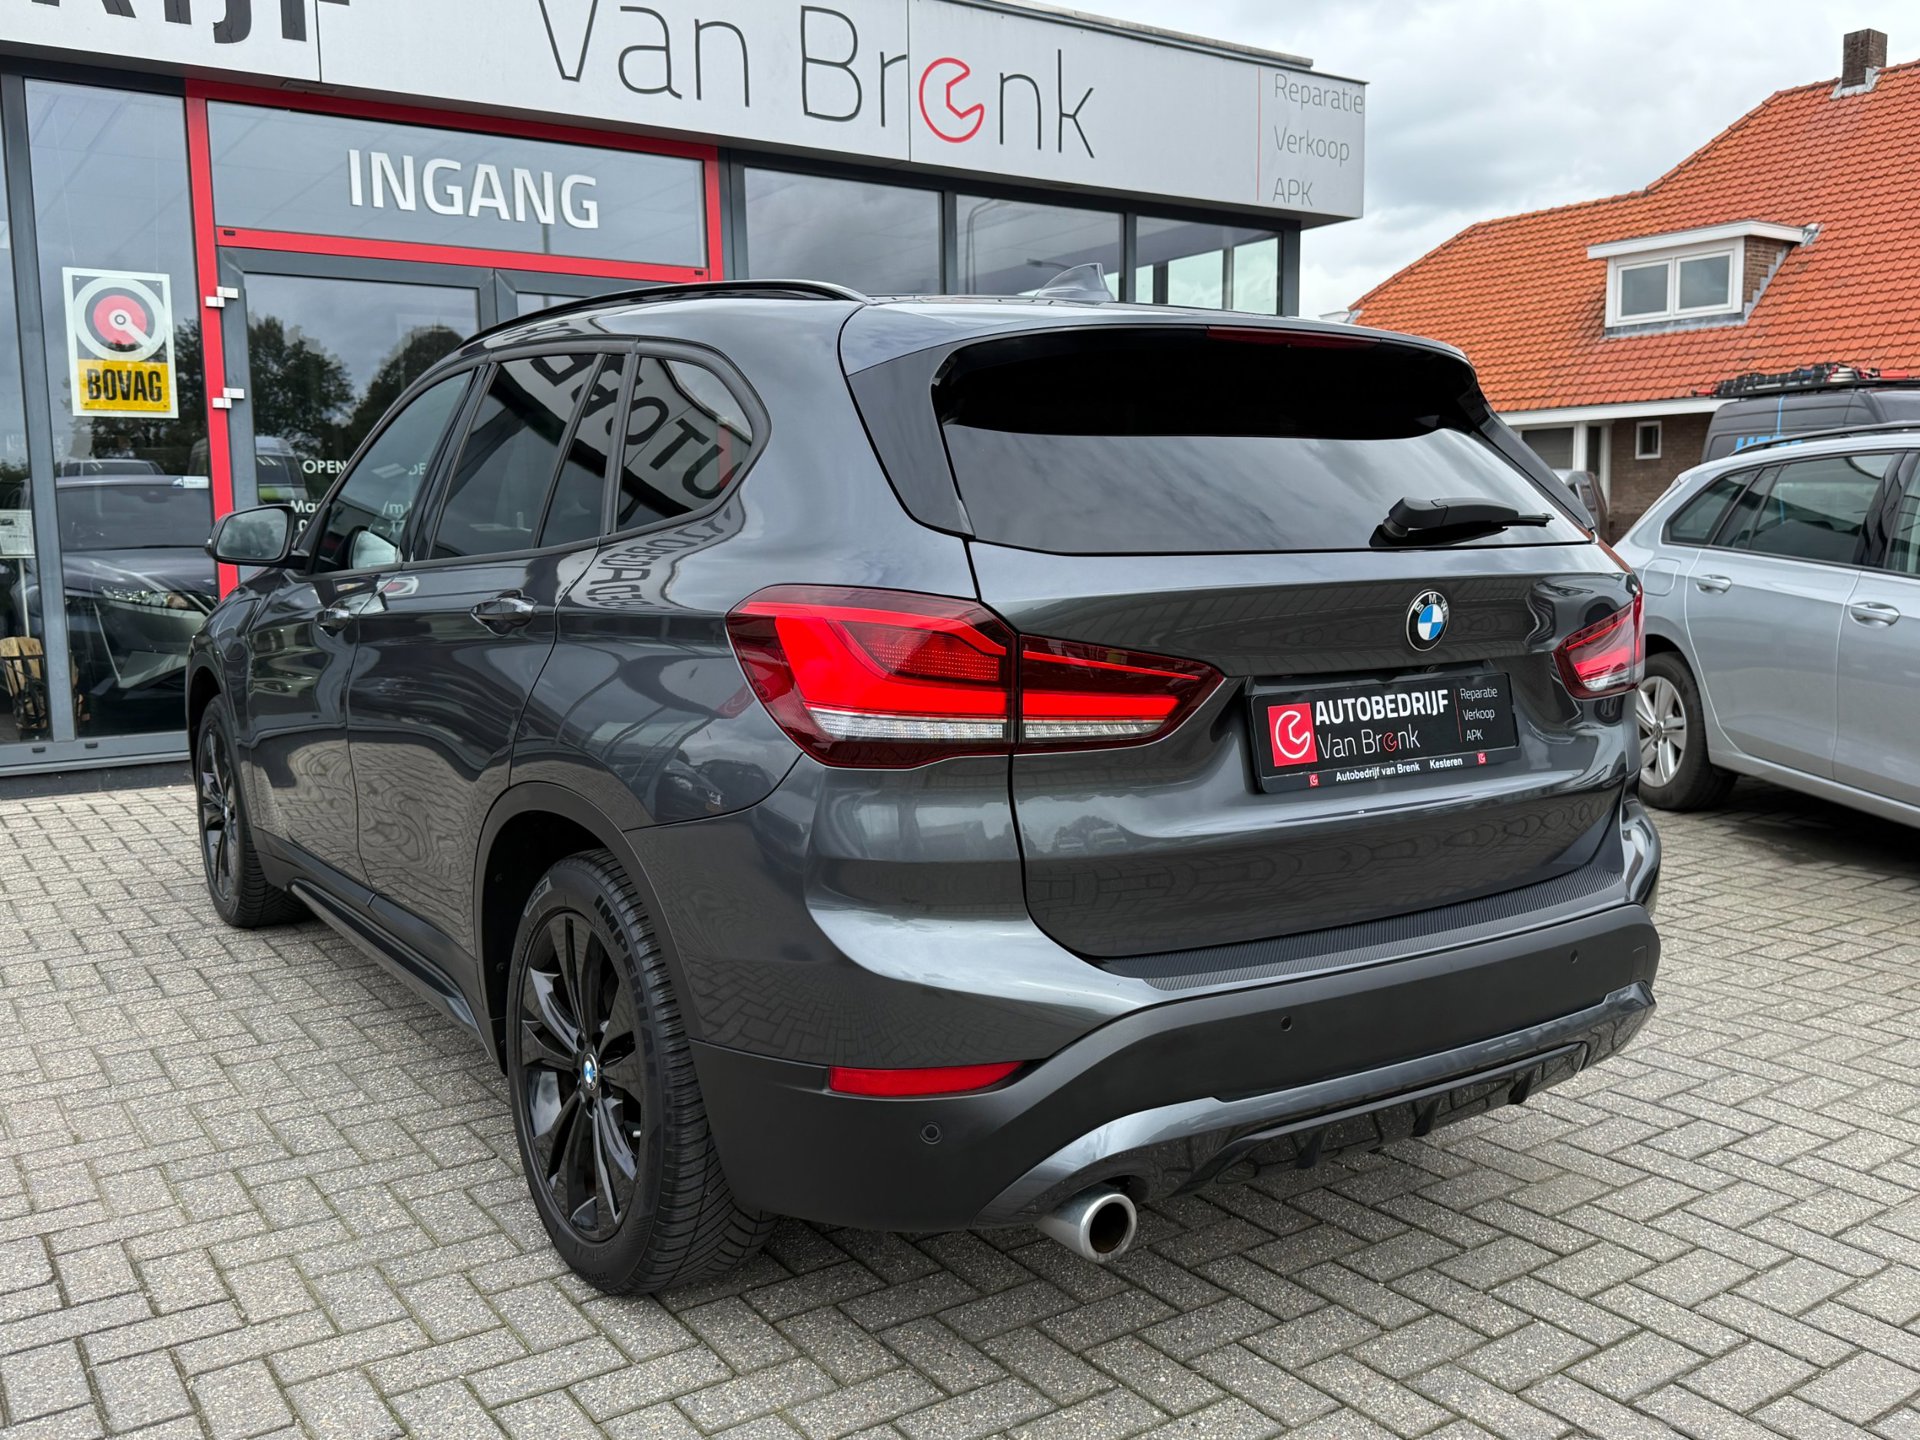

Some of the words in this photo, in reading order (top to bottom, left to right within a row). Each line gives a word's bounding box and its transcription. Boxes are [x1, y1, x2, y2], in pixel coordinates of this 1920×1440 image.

[537, 0, 751, 108] Van
[1274, 72, 1364, 114] Reparatie
[1273, 125, 1350, 168] Verkoop
[348, 148, 599, 230] INGANG
[1272, 177, 1313, 207] APK
[86, 368, 163, 403] BOVAG
[302, 459, 347, 474] OPEN
[1315, 689, 1449, 726] AUTOBEDRIJF
[1459, 687, 1498, 701] Reparatie
[1462, 708, 1496, 722] Verkoop
[1317, 733, 1358, 759] Van
[1465, 729, 1484, 742] APK
[1335, 767, 1381, 783] Autobedrijf
[1381, 765, 1396, 776] van
[1397, 761, 1421, 774] Brenk
[1429, 756, 1464, 770] Kesteren
